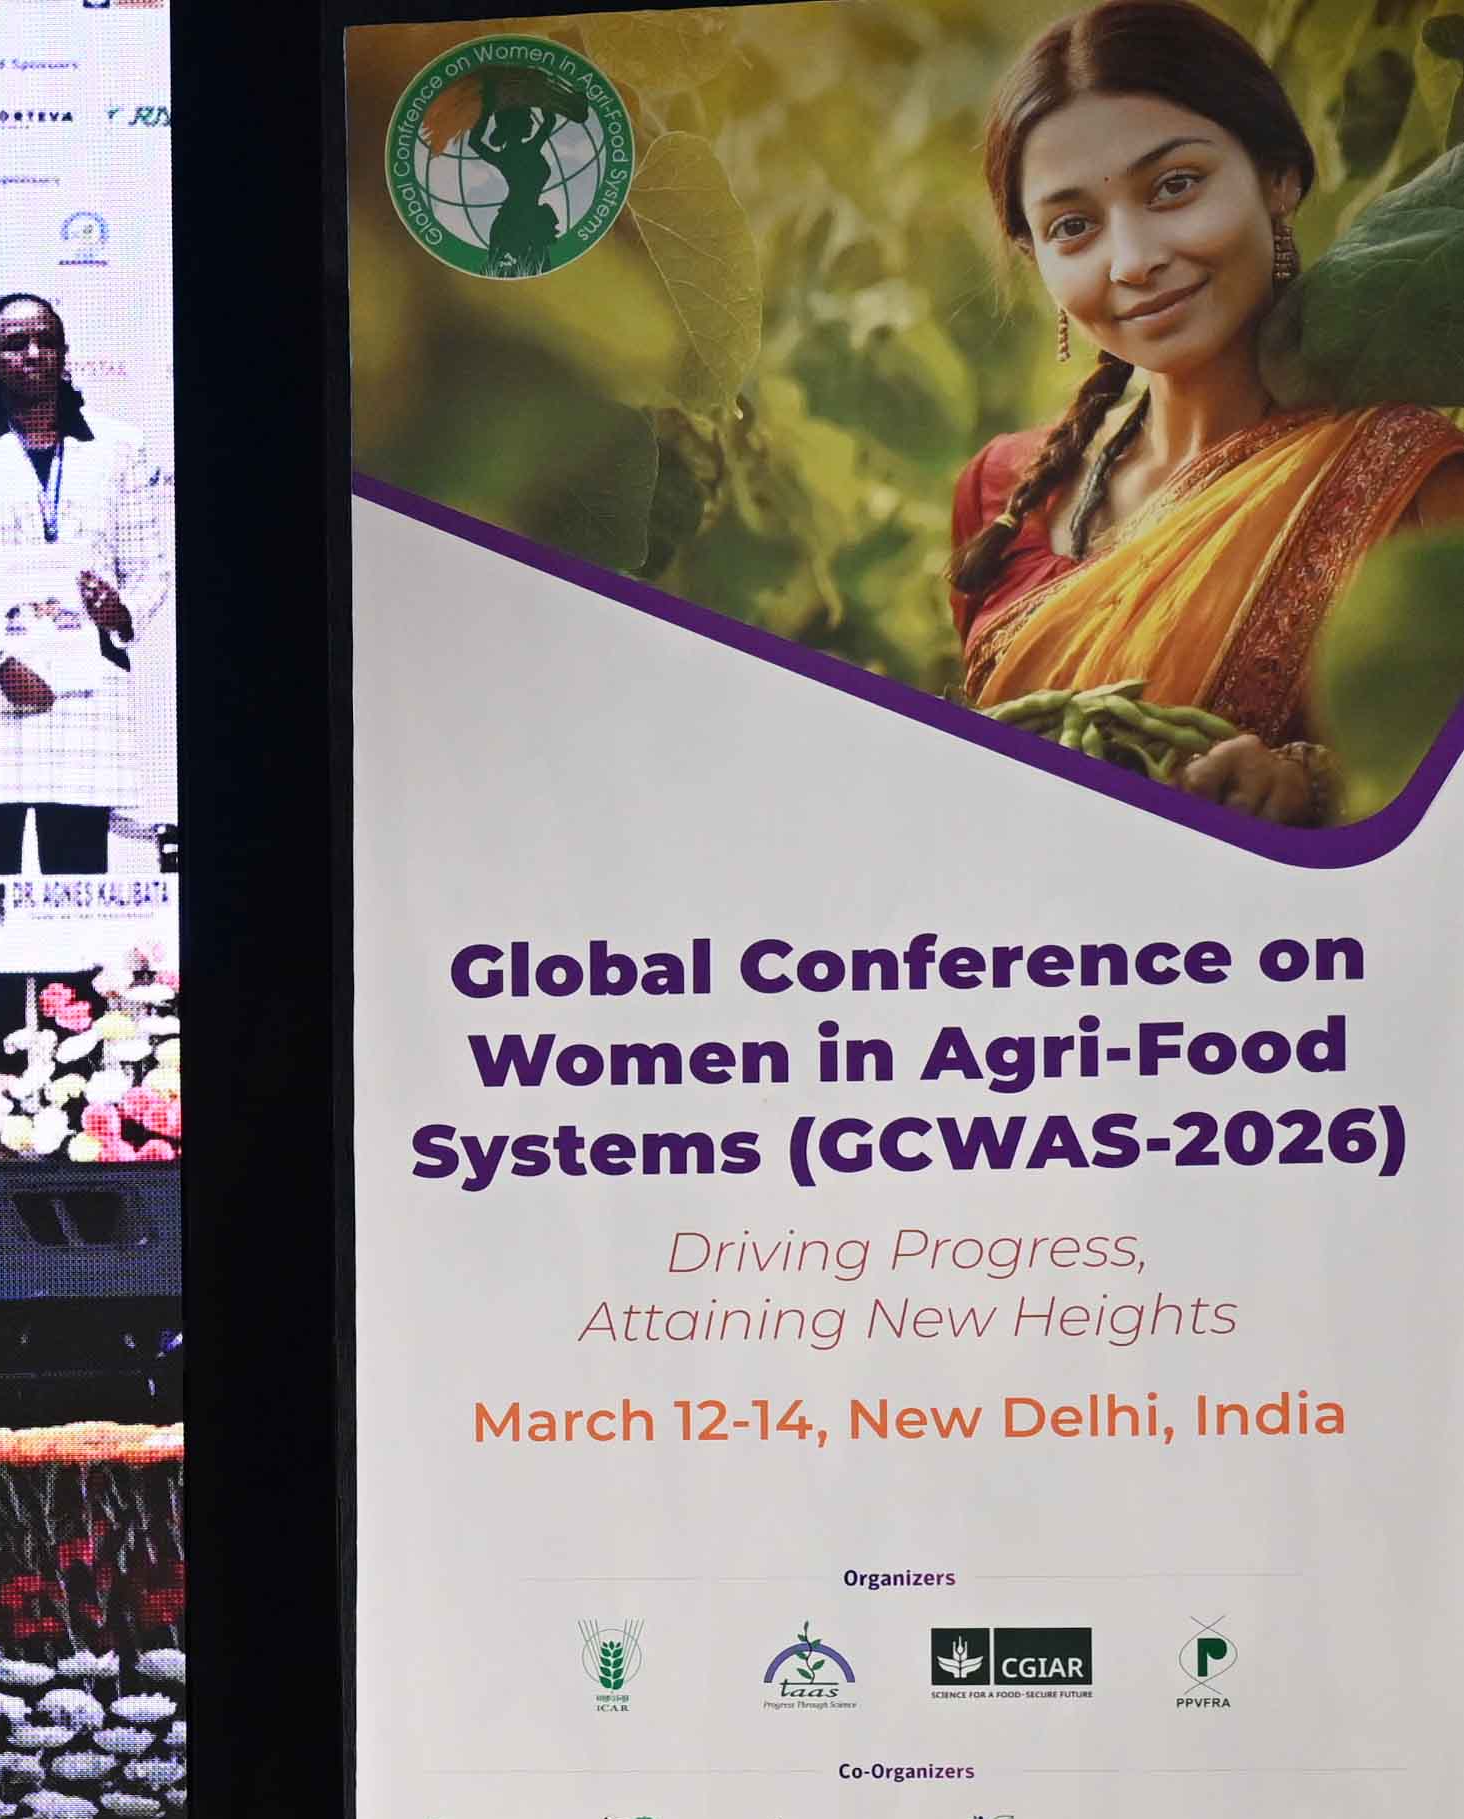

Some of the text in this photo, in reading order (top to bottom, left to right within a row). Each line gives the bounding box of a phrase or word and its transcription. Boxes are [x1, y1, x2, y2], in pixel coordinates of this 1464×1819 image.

[398, 184, 443, 246] Global
[445, 56, 471, 77] on
[473, 44, 555, 65] Women
[560, 57, 575, 76] in
[577, 168, 627, 241] Systems
[451, 933, 1364, 998] Global Conference on
[469, 1015, 1346, 1093] Women in Agri-Food
[413, 1105, 1405, 1192] Systems (GCWAS-2026)
[669, 1230, 1144, 1280] Driving Progress,
[579, 1292, 1238, 1350] Attaining New Heights
[475, 1391, 1344, 1448] March 12-14, New Delhi, India
[844, 1570, 955, 1590] Organizers
[1002, 1658, 1083, 1678] CGIAR
[779, 1682, 839, 1698] taas
[931, 1690, 966, 1699] SCIENCE
[968, 1690, 987, 1699] FOR
[1061, 1690, 1093, 1699] FUTURE
[1176, 1698, 1231, 1708] PPVFRA
[597, 1704, 629, 1712] ICAR
[839, 1764, 974, 1782] Co-Organizers
